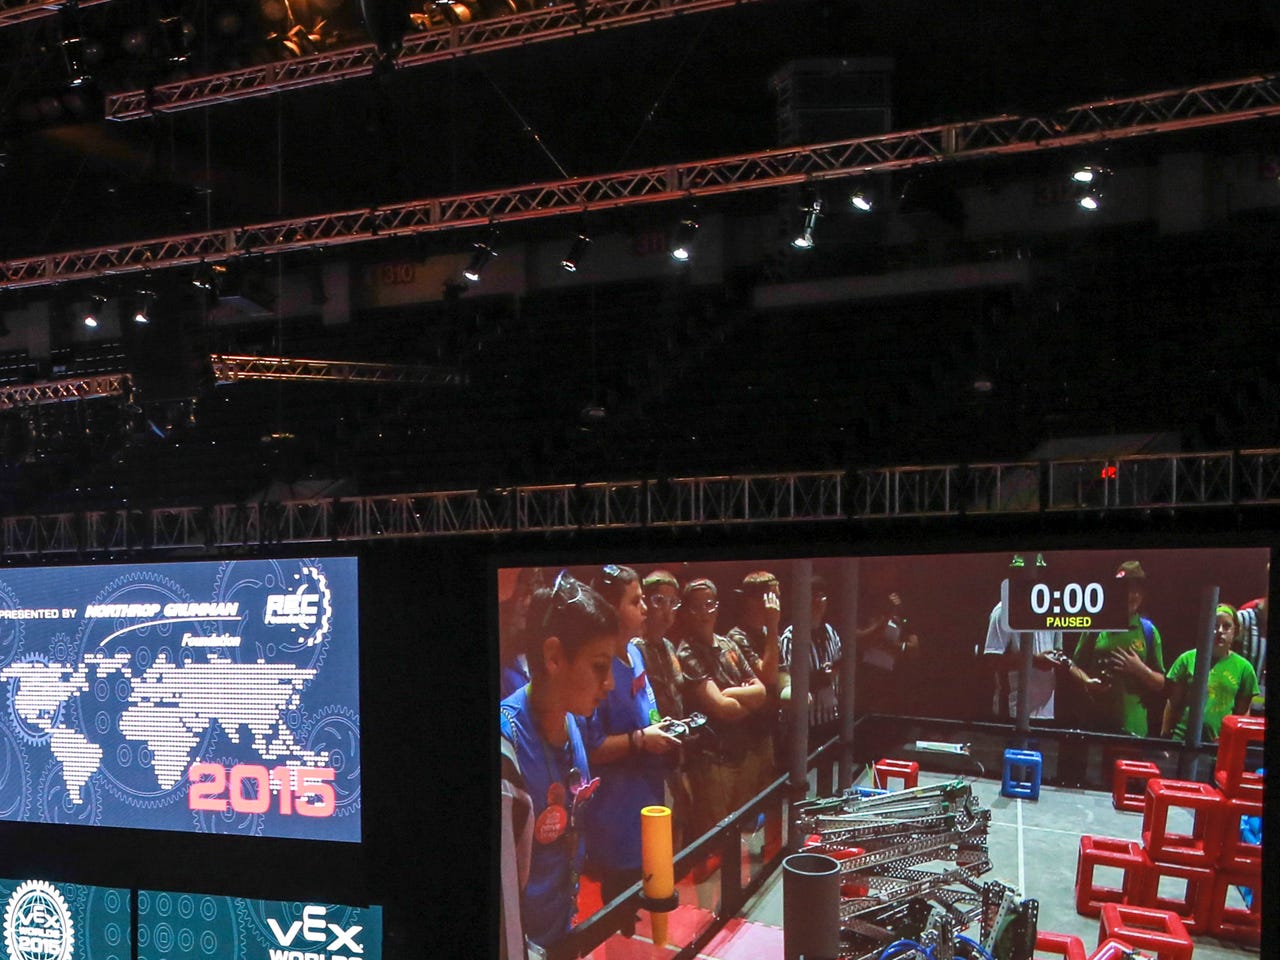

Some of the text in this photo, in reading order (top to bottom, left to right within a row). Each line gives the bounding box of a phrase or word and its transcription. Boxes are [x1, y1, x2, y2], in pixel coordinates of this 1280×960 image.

[1030, 582, 1105, 614] 0:00
[61, 608, 77, 618] BY
[84, 604, 161, 618] NORTHROP
[163, 602, 239, 617] GRUMMAN
[1046, 616, 1092, 627] PAUSED
[181, 632, 241, 647] Foundation
[188, 763, 336, 817] 2015
[19, 905, 60, 928] VEX
[267, 905, 364, 953] VEX
[19, 936, 60, 955] 2015
